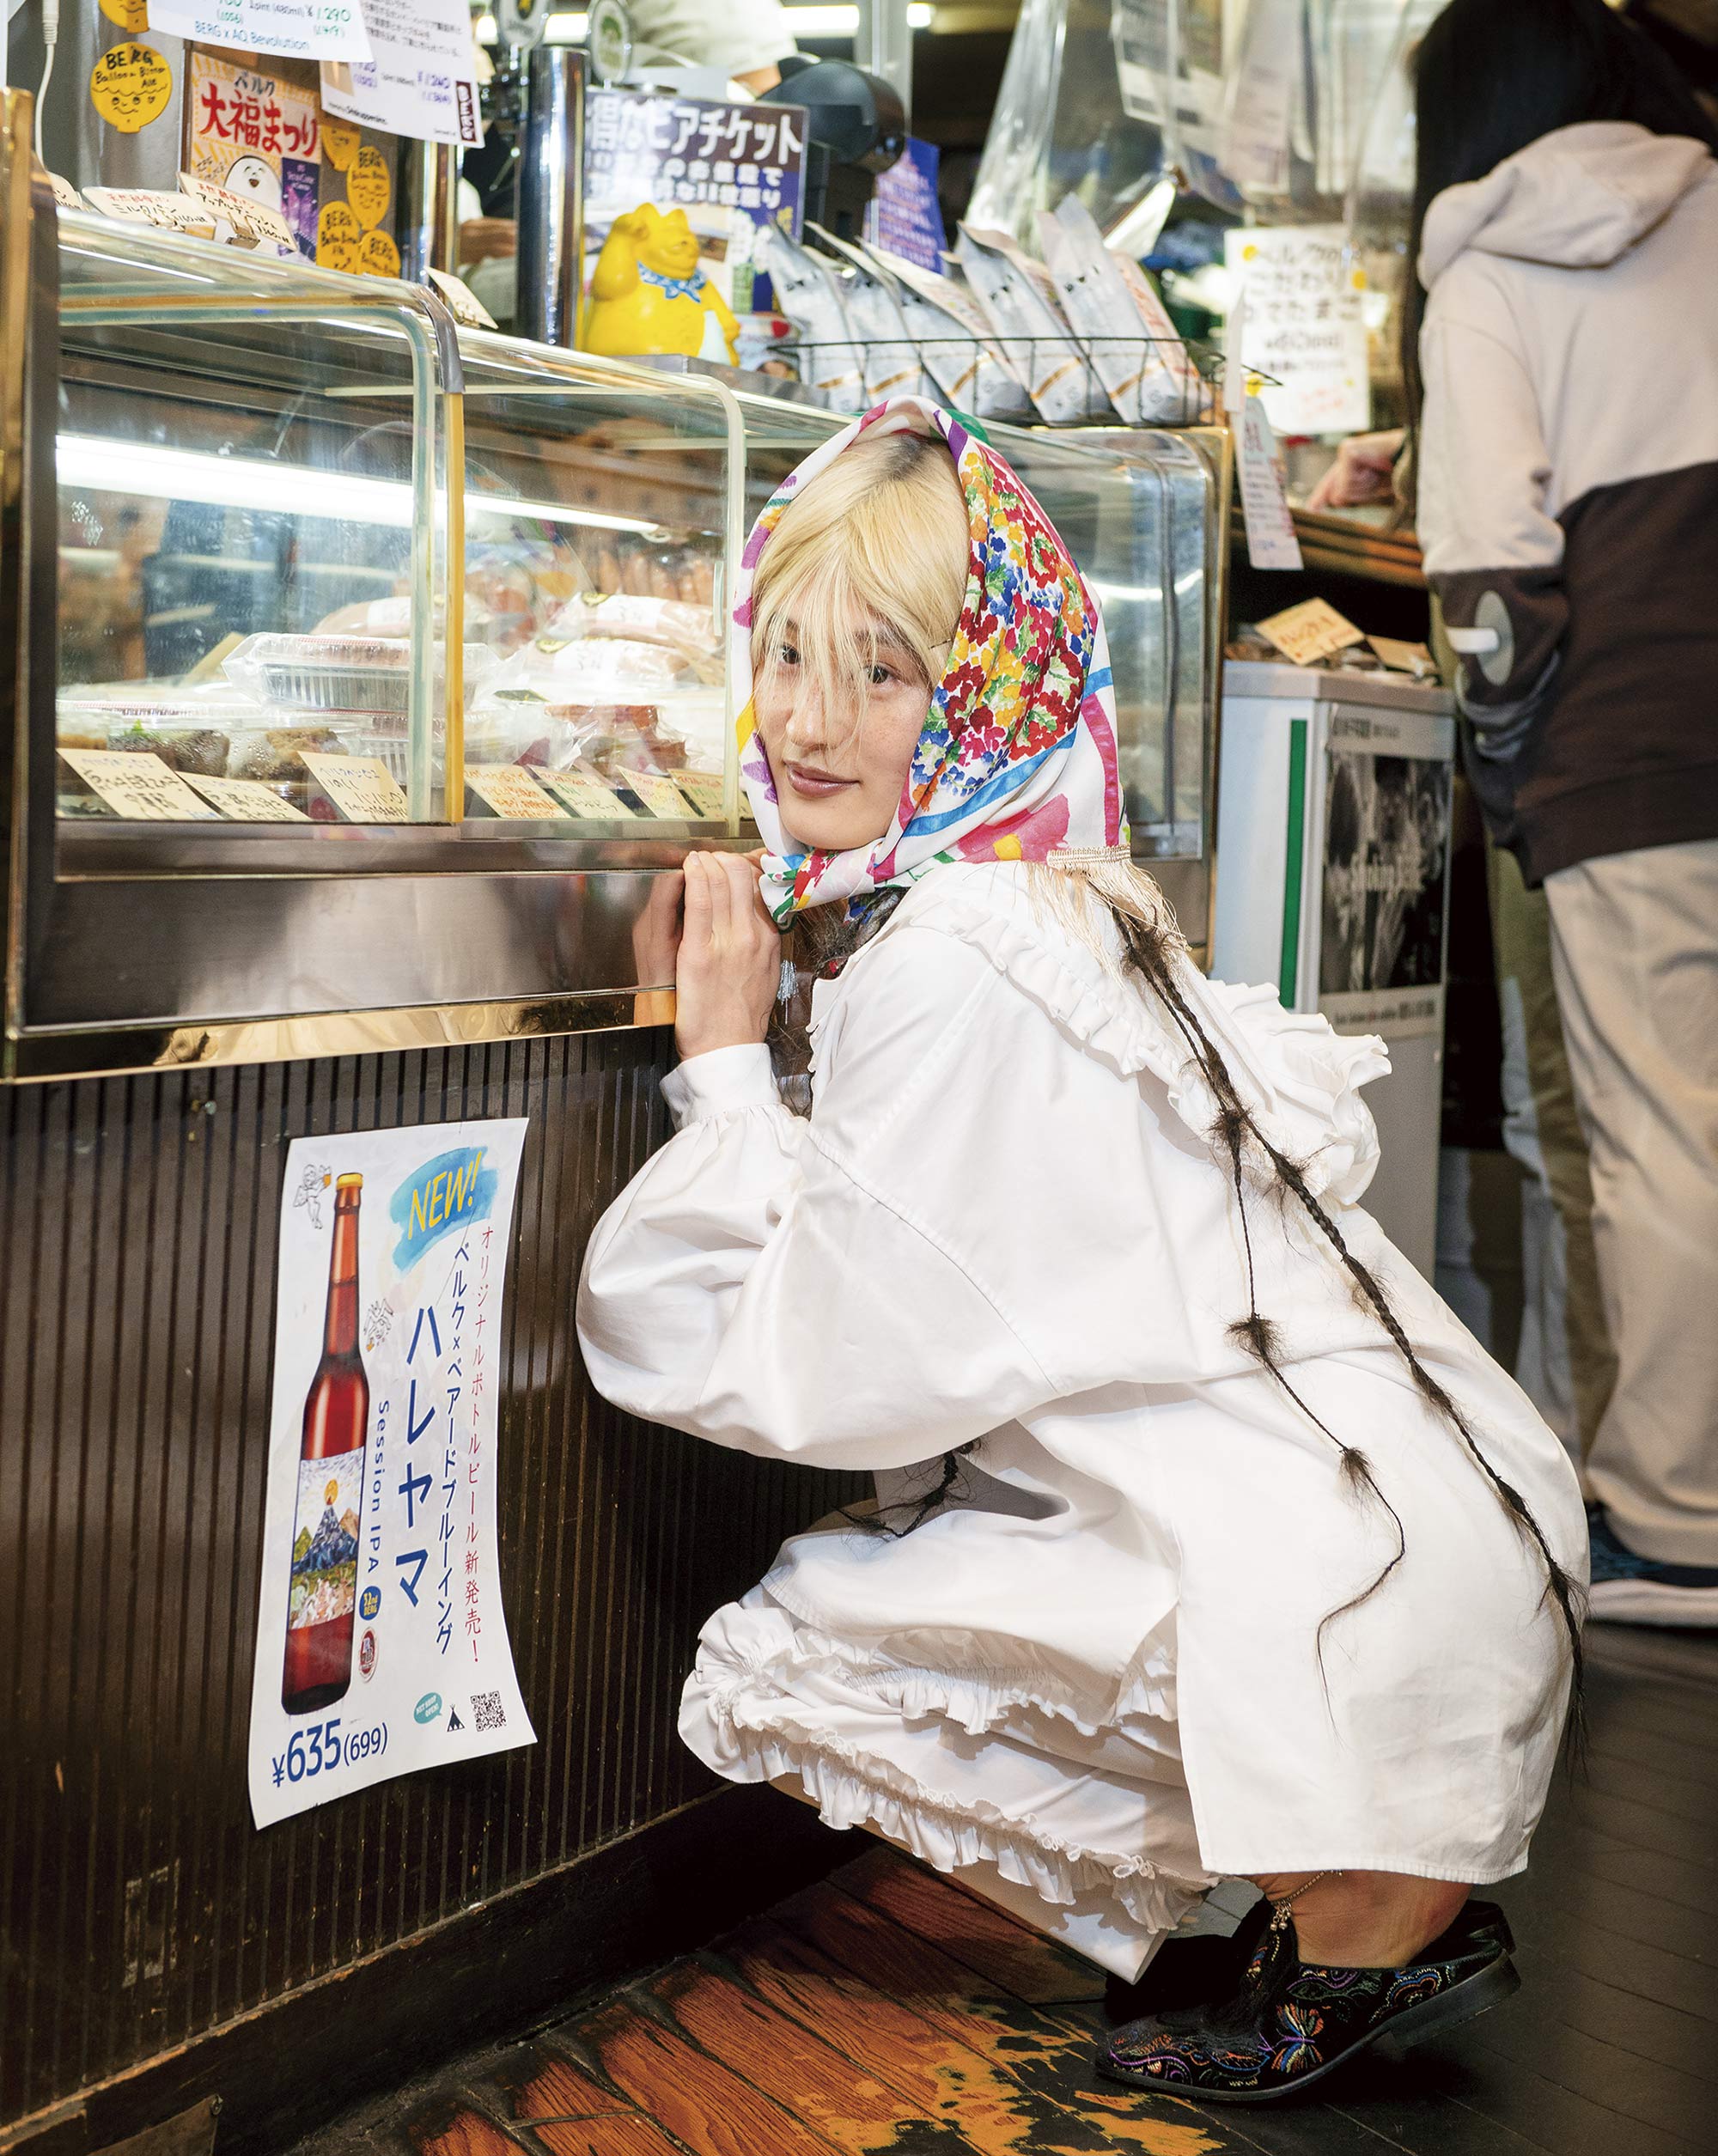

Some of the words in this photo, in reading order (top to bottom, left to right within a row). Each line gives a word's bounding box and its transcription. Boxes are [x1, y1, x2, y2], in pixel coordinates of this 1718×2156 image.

[106, 47, 154, 70] BERG
[234, 70, 276, 98] ベルク
[198, 82, 318, 157] 大福まつり
[408, 1151, 483, 1239] NEW!
[371, 1400, 390, 1513] Session
[395, 1305, 443, 1608] ハレヤマ
[368, 1524, 381, 1574] IPA
